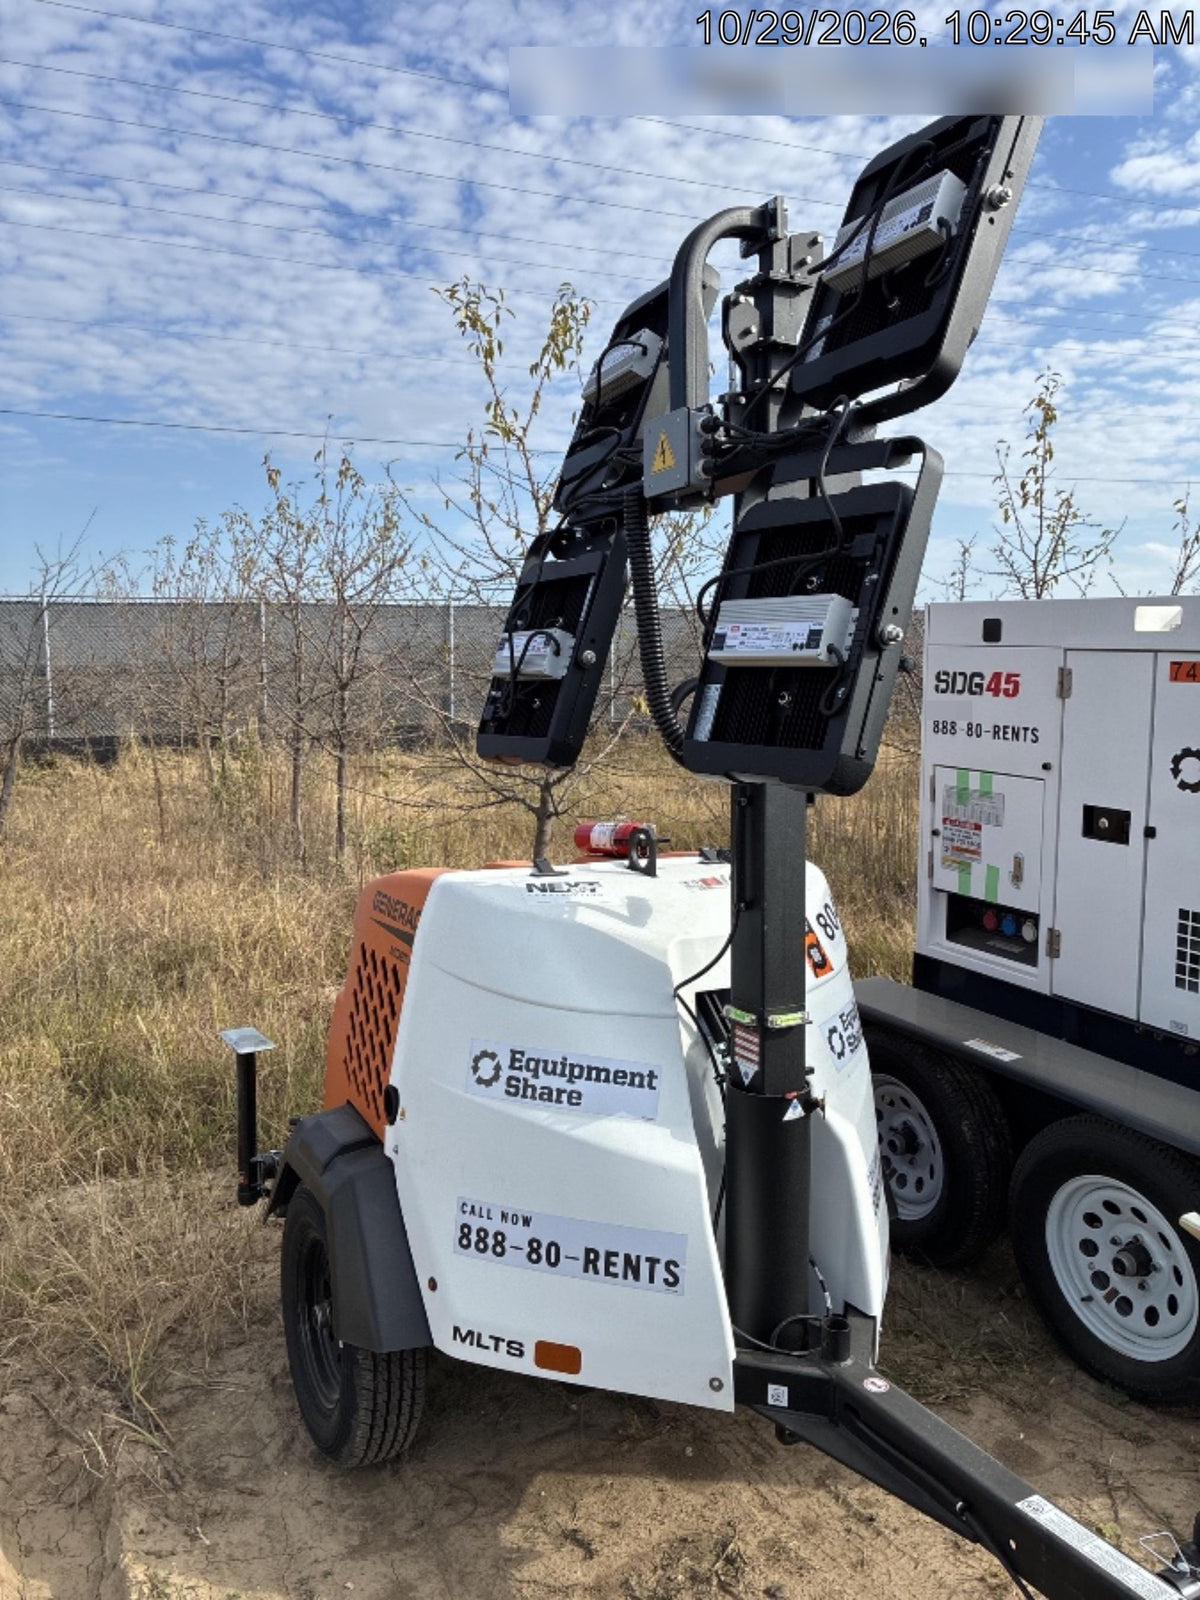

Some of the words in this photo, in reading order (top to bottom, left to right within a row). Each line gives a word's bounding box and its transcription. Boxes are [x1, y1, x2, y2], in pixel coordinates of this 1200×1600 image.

[934, 669, 1021, 698] SDG45
[932, 719, 1040, 744] 888-80-RENTS
[508, 1049, 658, 1090] Equipment
[504, 1075, 583, 1106] Share
[460, 1202, 494, 1221] CALL
[500, 1209, 533, 1229] NOW
[458, 1223, 681, 1288] 888-80-RENTS
[452, 1326, 525, 1359] MLTS
